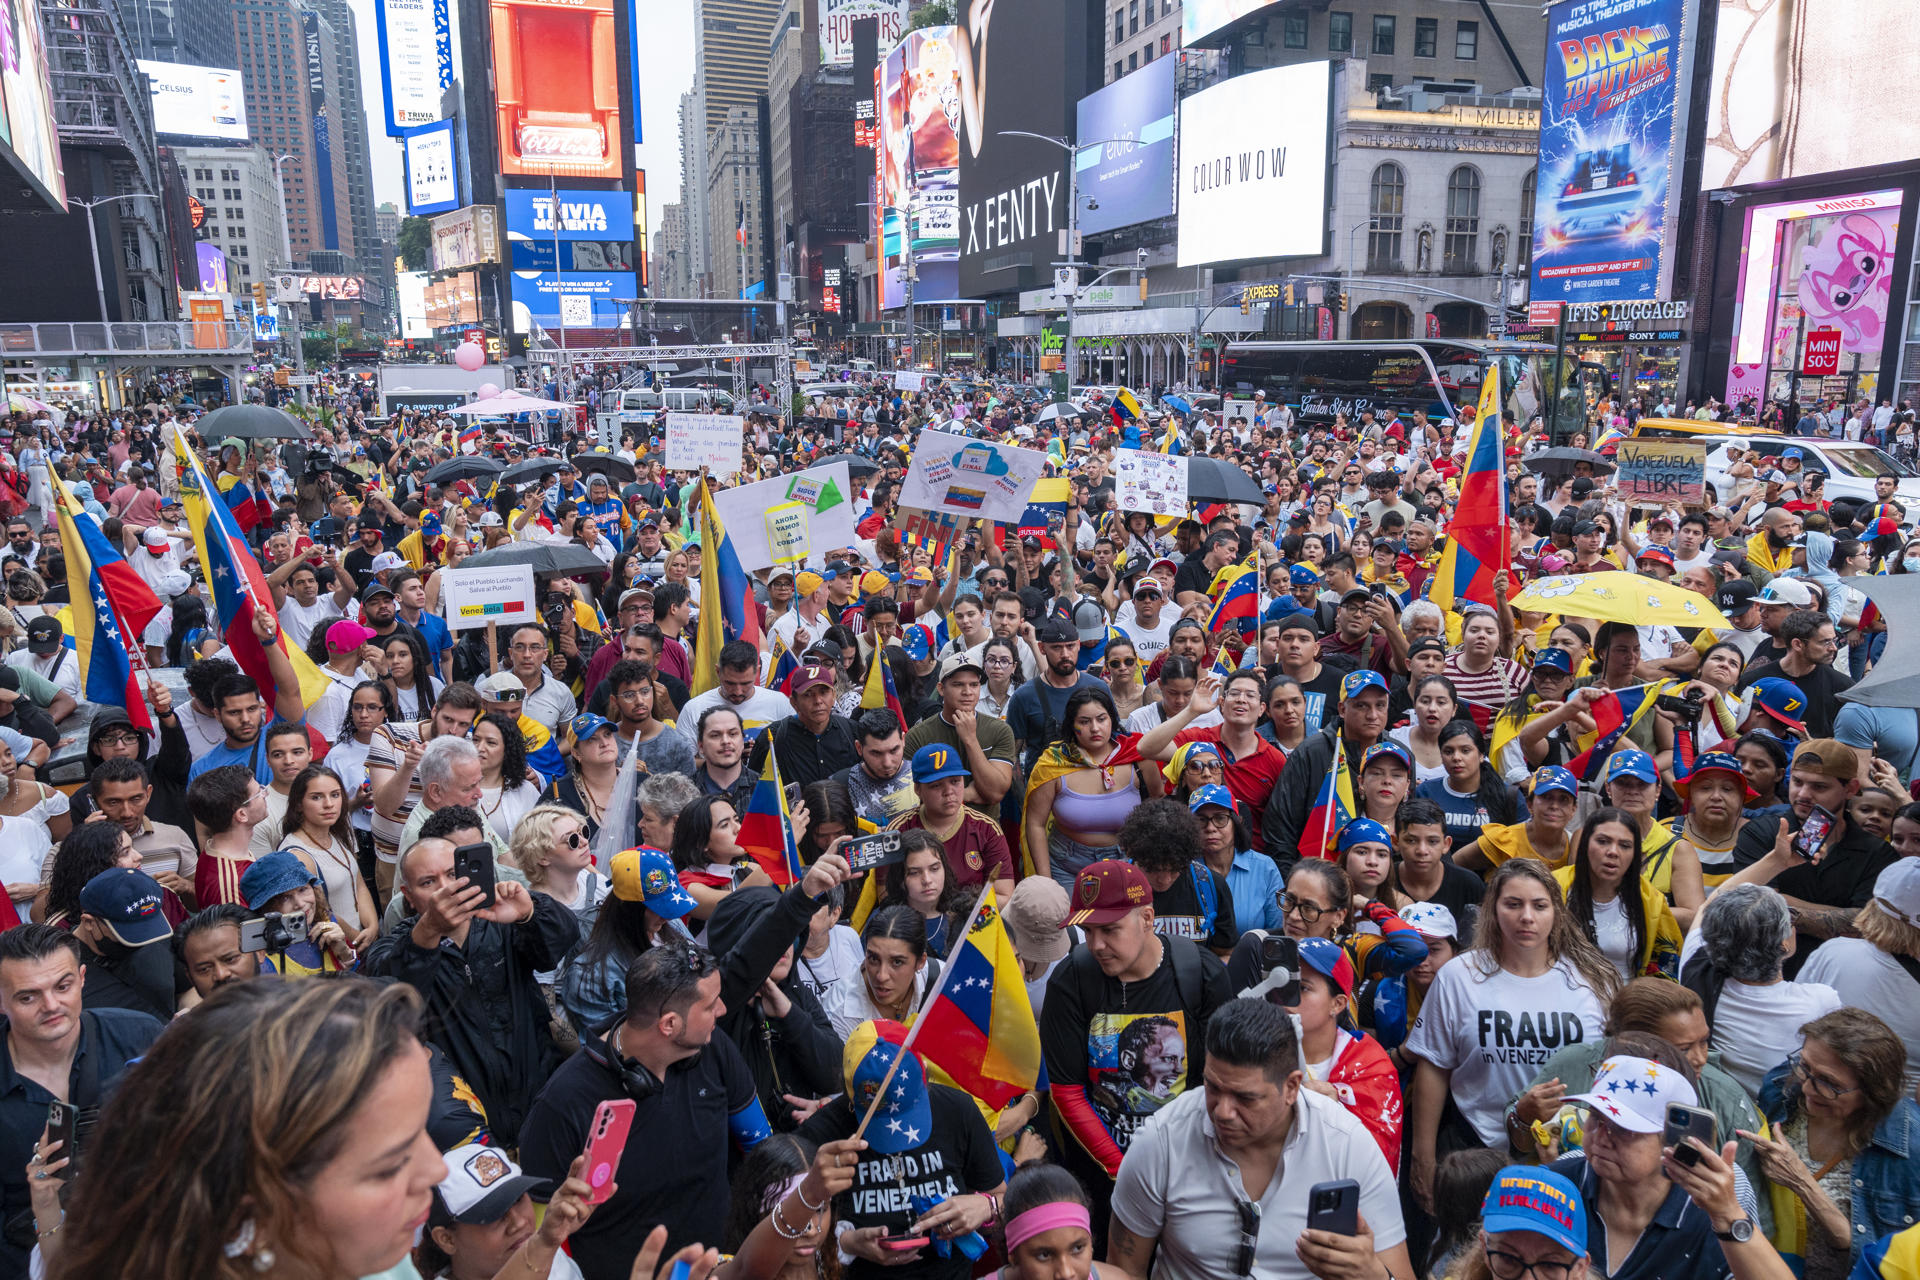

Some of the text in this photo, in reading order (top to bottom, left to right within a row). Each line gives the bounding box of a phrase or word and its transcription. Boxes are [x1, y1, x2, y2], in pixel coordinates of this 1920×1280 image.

[1557, 3, 1637, 35] MUSICAL THEATER
[1559, 26, 1652, 79] BACK
[1585, 46, 1669, 106] FUTURE
[159, 84, 194, 94] CELSIUS
[1566, 77, 1586, 99] TO
[1609, 73, 1665, 108] THE MUSICAL
[1561, 95, 1585, 118] THE
[1476, 109, 1537, 126] MILLER
[1106, 123, 1134, 160] elvie
[1364, 134, 1384, 145] THE
[1388, 135, 1420, 147] SHOW
[1462, 139, 1490, 151] SHOE
[1493, 140, 1522, 153] SHOP
[1194, 146, 1287, 194] COLOR WOW
[925, 194, 955, 202] 100
[1816, 198, 1876, 212] MINISO
[967, 171, 1060, 255] X FENTY
[1541, 268, 1569, 278] BROADWAY
[1570, 265, 1597, 275] BETWEEN
[1609, 263, 1622, 271] AND
[1632, 260, 1640, 269] ST
[1572, 280, 1587, 289] WINTER
[1587, 279, 1602, 288] GARDEN
[1243, 284, 1279, 300] EXPRESS
[1567, 302, 1687, 323] IFTS LUGGAGE
[1578, 331, 1681, 341] Nikon Canon SONY BOWER
[1809, 340, 1837, 352] MINI
[1729, 386, 1761, 394] BLIND
[447, 402, 458, 411] of
[1300, 395, 1353, 418] Garden State
[961, 463, 983, 471] FINAL
[1634, 472, 1692, 495] LIBRE
[796, 487, 816, 497] SIGUE
[775, 514, 799, 525] AHORA
[776, 521, 800, 532] VAMOS
[610, 522, 619, 536] 13
[776, 535, 803, 547] COBRAR
[496, 576, 524, 584] Luchando
[460, 605, 501, 615] Venezuela
[1445, 812, 1490, 827] ONDON
[864, 841, 877, 865] CALM
[875, 842, 885, 859] KEEP
[1127, 885, 1143, 893] MANO
[1128, 890, 1145, 899] TENGO
[1478, 1010, 1584, 1049] FRAUD
[1481, 1049, 1495, 1063] in
[858, 1150, 944, 1186] FRAUD IN
